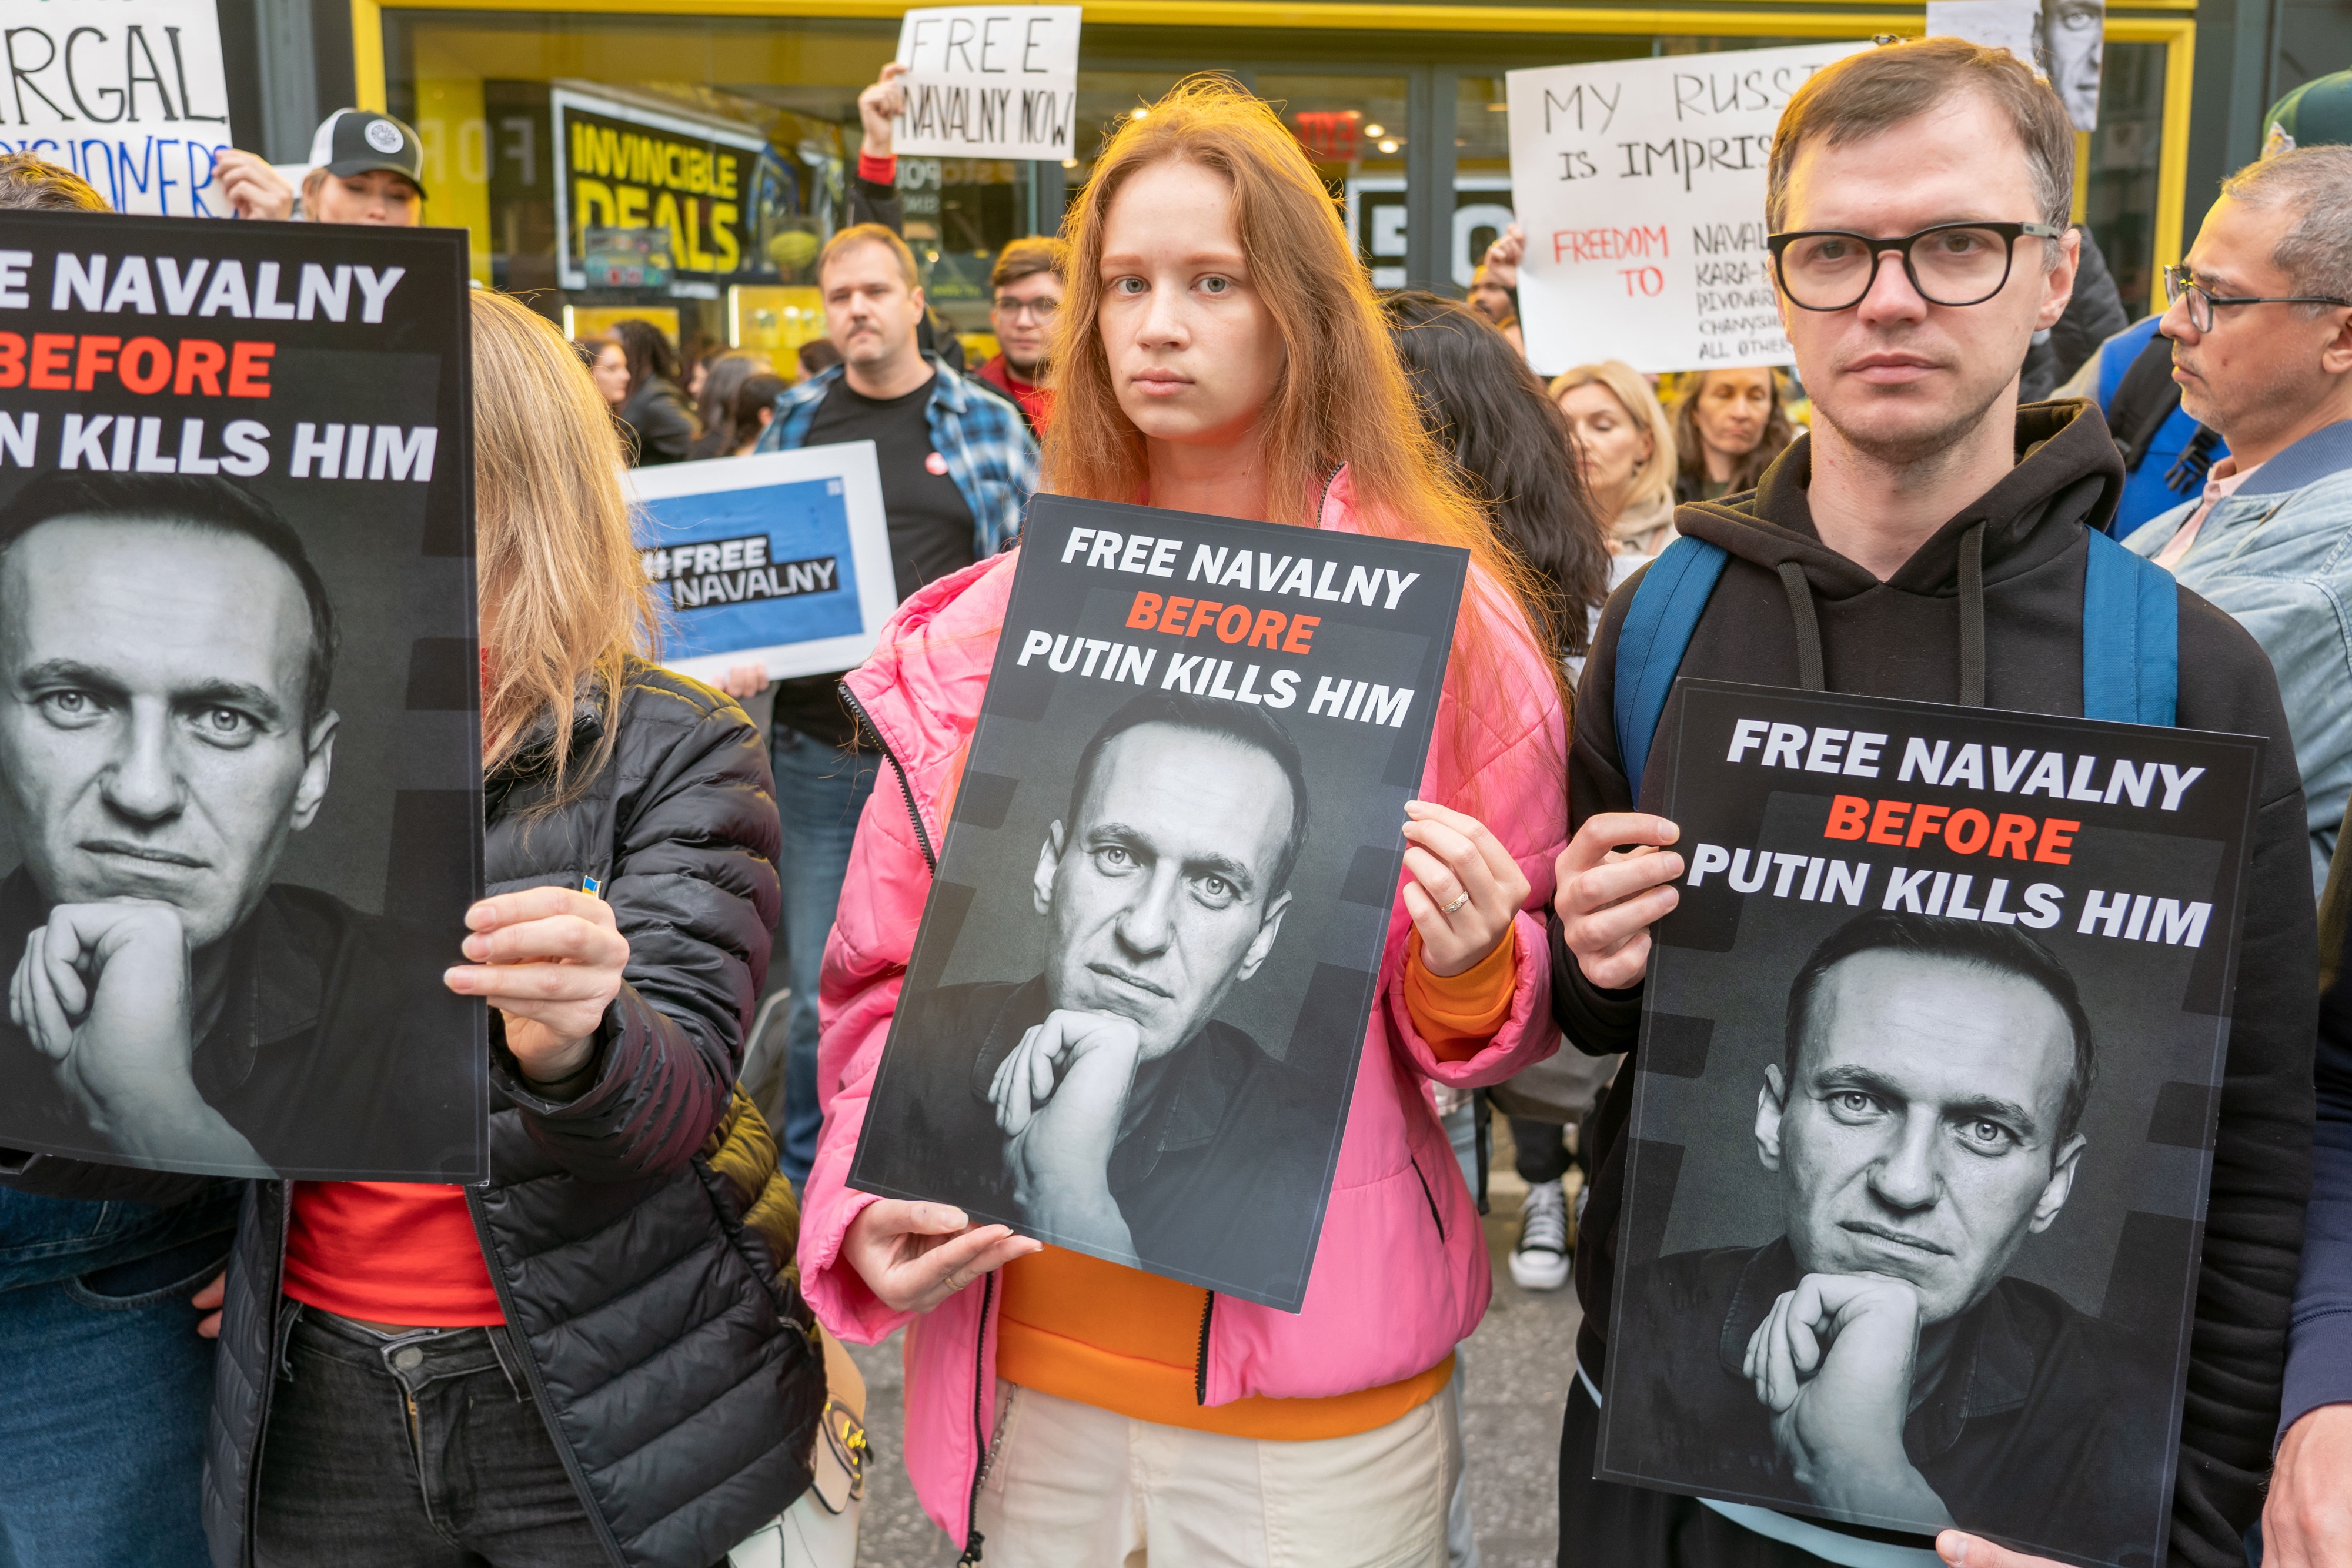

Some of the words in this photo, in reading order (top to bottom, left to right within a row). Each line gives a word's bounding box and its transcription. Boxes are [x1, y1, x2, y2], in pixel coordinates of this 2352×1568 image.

[0, 25, 228, 125] RGAL
[910, 16, 1054, 73] FREE
[901, 84, 1011, 144] NAVALNY
[1019, 89, 1075, 146] NOW
[1544, 82, 1622, 135] MY
[1674, 63, 1824, 121] RUSS
[571, 121, 737, 200] INVINCIBLE
[1559, 150, 1598, 181] IS
[575, 178, 740, 275] DEALS
[1552, 224, 1669, 263] FREEDOM
[52, 252, 406, 323] NAVALNY
[1617, 265, 1664, 297] TO
[1699, 340, 1729, 360] ALL
[59, 413, 271, 477] KILLS
[290, 422, 439, 482] HIM
[640, 536, 768, 581] #FREE
[674, 559, 836, 609] NAVALNY
[1061, 526, 1184, 579] FREE
[1186, 544, 1421, 610] NAVALNY
[1125, 590, 1322, 655] BEFORE
[1016, 630, 1157, 686] PUTIN
[1160, 653, 1302, 708] KILLS
[1307, 676, 1415, 728] HIM
[1726, 718, 1889, 779] FREE
[1897, 737, 2206, 811] NAVALNY
[1823, 794, 2081, 865] BEFORE
[1686, 842, 1871, 907] PUTIN
[1882, 867, 2065, 930] KILLS
[2077, 889, 2213, 948] HIM
